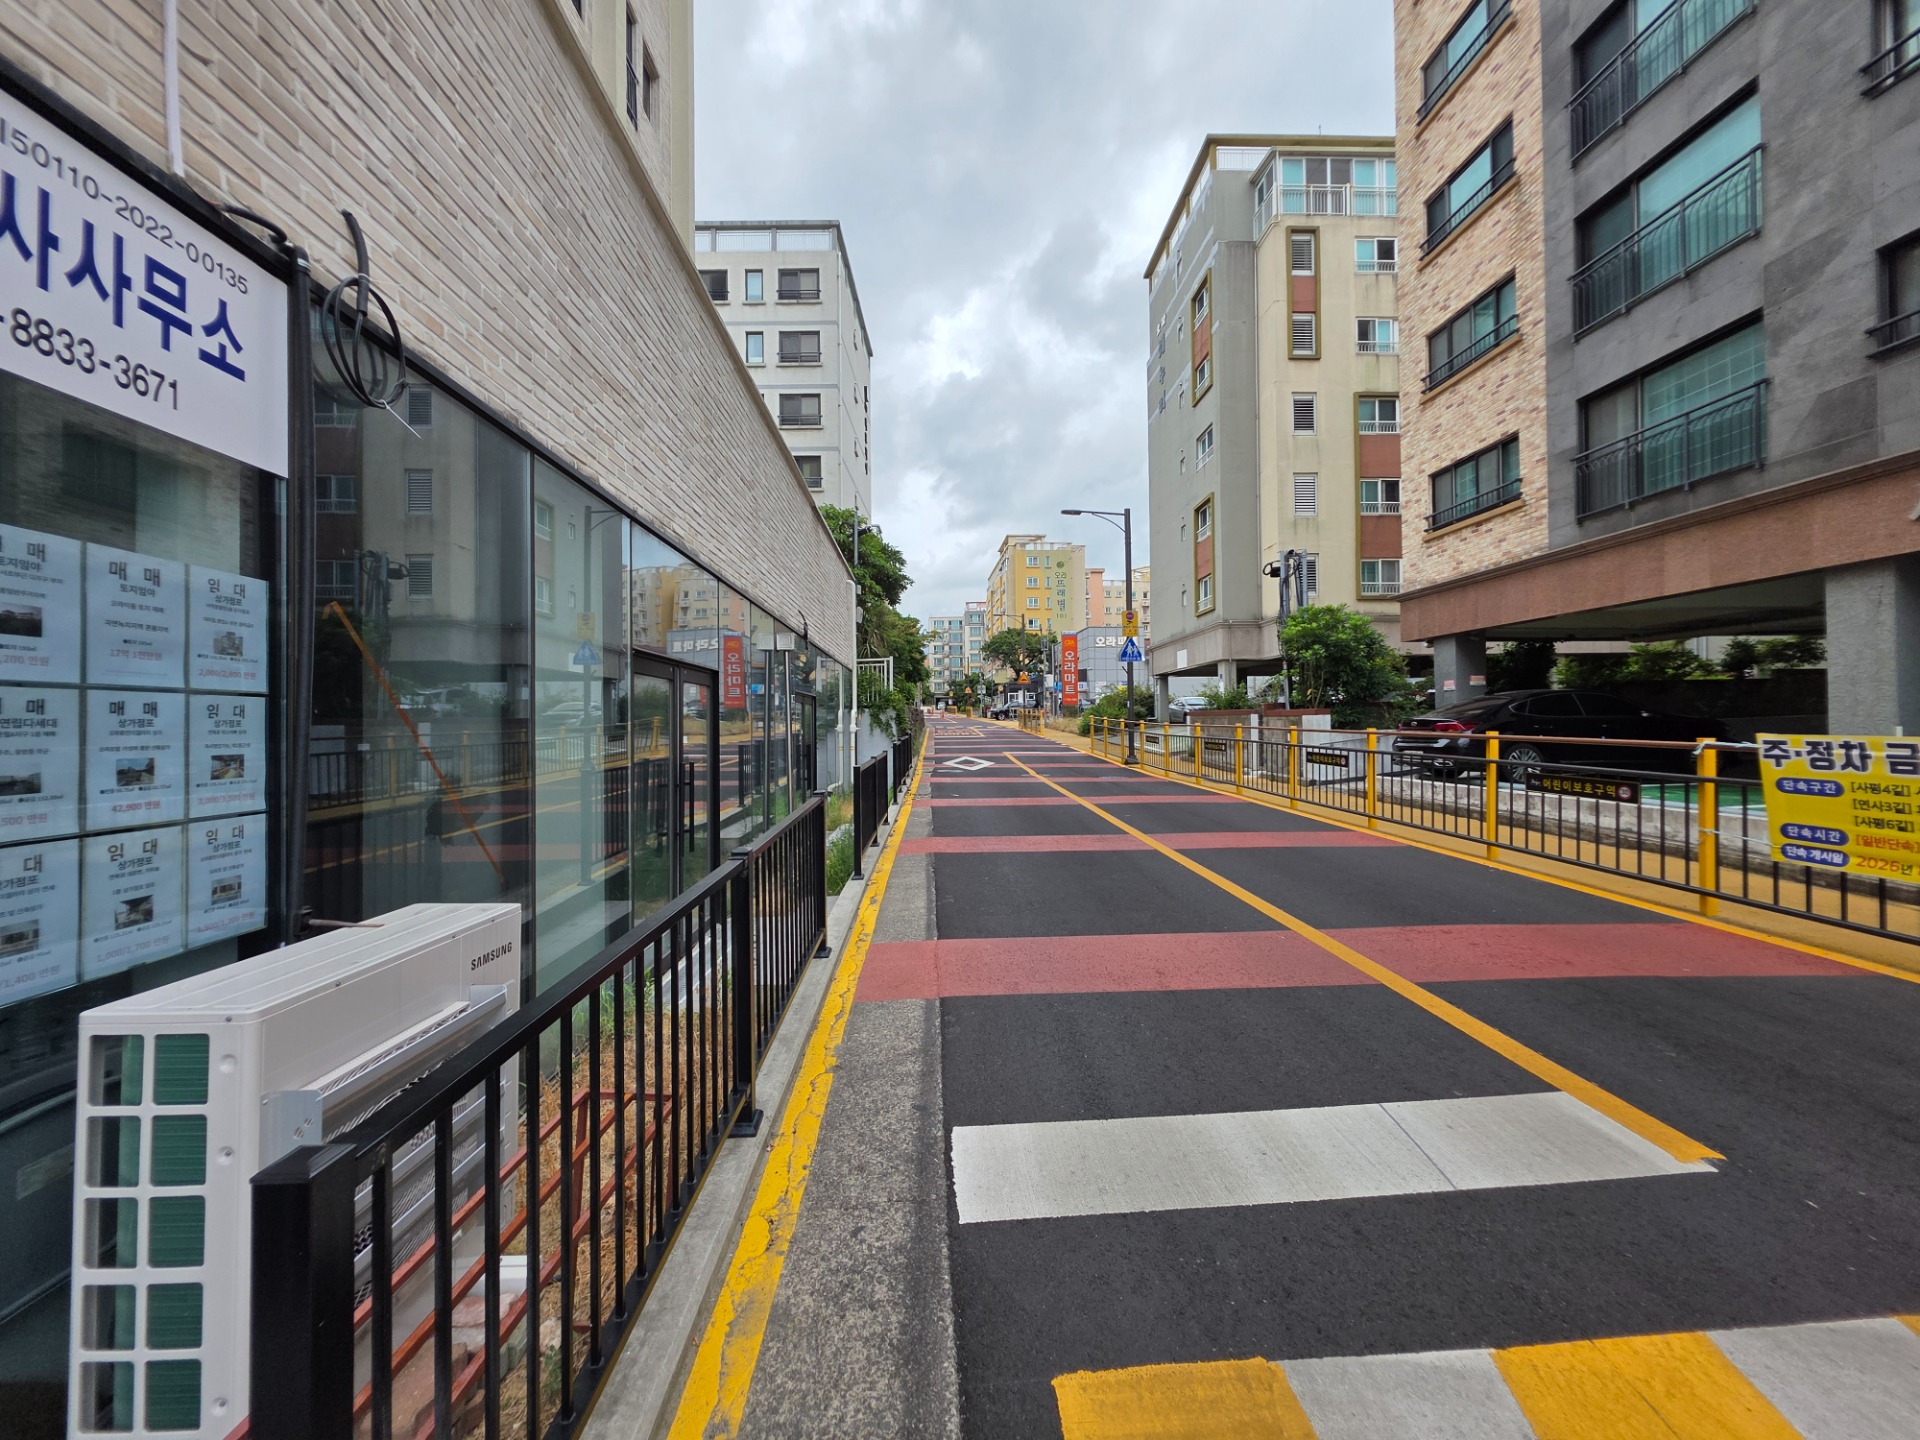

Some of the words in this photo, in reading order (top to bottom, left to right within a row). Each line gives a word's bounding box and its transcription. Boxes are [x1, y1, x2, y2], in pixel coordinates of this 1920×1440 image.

[1064, 650, 1076, 695] 오라마트
[1542, 777, 1617, 798] 어린이보호구역
[1783, 780, 1837, 794] 단속구간
[1787, 825, 1841, 843] 단속시간
[1785, 845, 1808, 859] 단속
[470, 941, 513, 972] SAMSUNG
